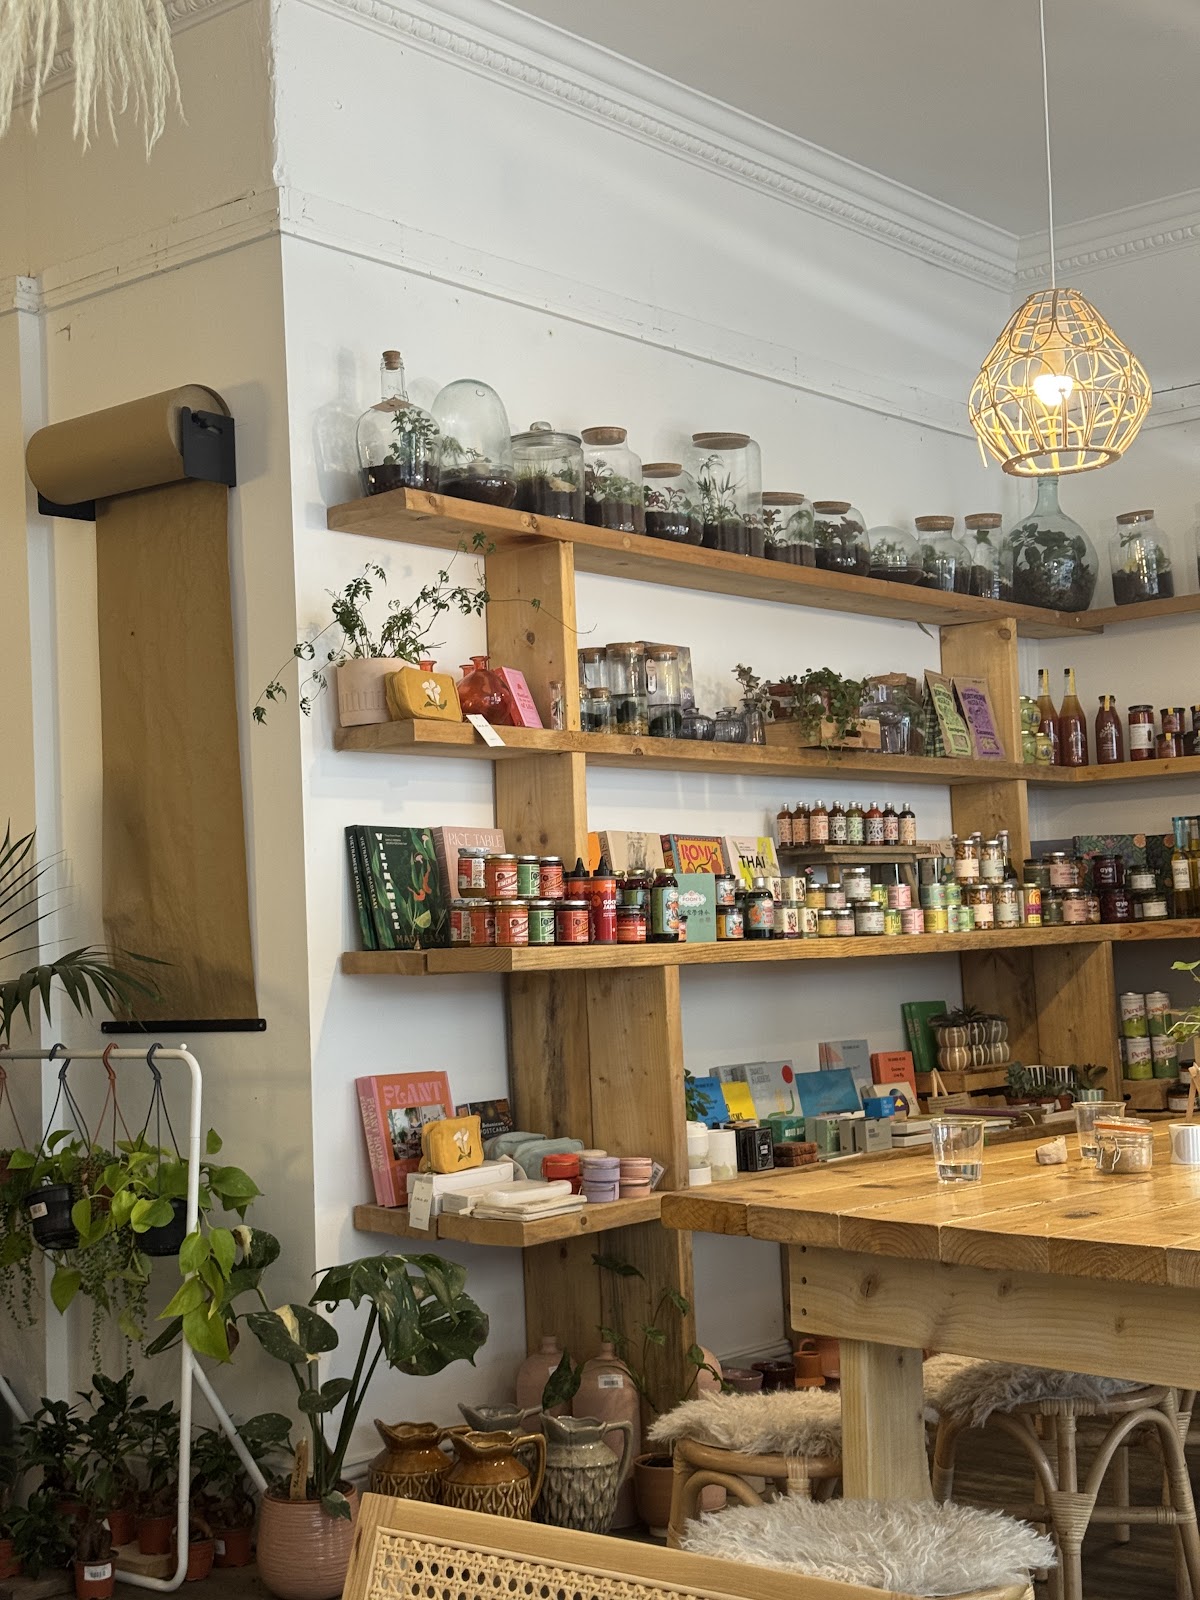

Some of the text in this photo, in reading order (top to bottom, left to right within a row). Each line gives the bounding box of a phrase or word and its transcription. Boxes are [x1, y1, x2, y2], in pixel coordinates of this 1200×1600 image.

[448, 833, 503, 848] RICE TABLE
[739, 855, 766, 869] THAI
[375, 832, 401, 930] VIETNAMESE
[382, 1081, 443, 1106] PLANT
